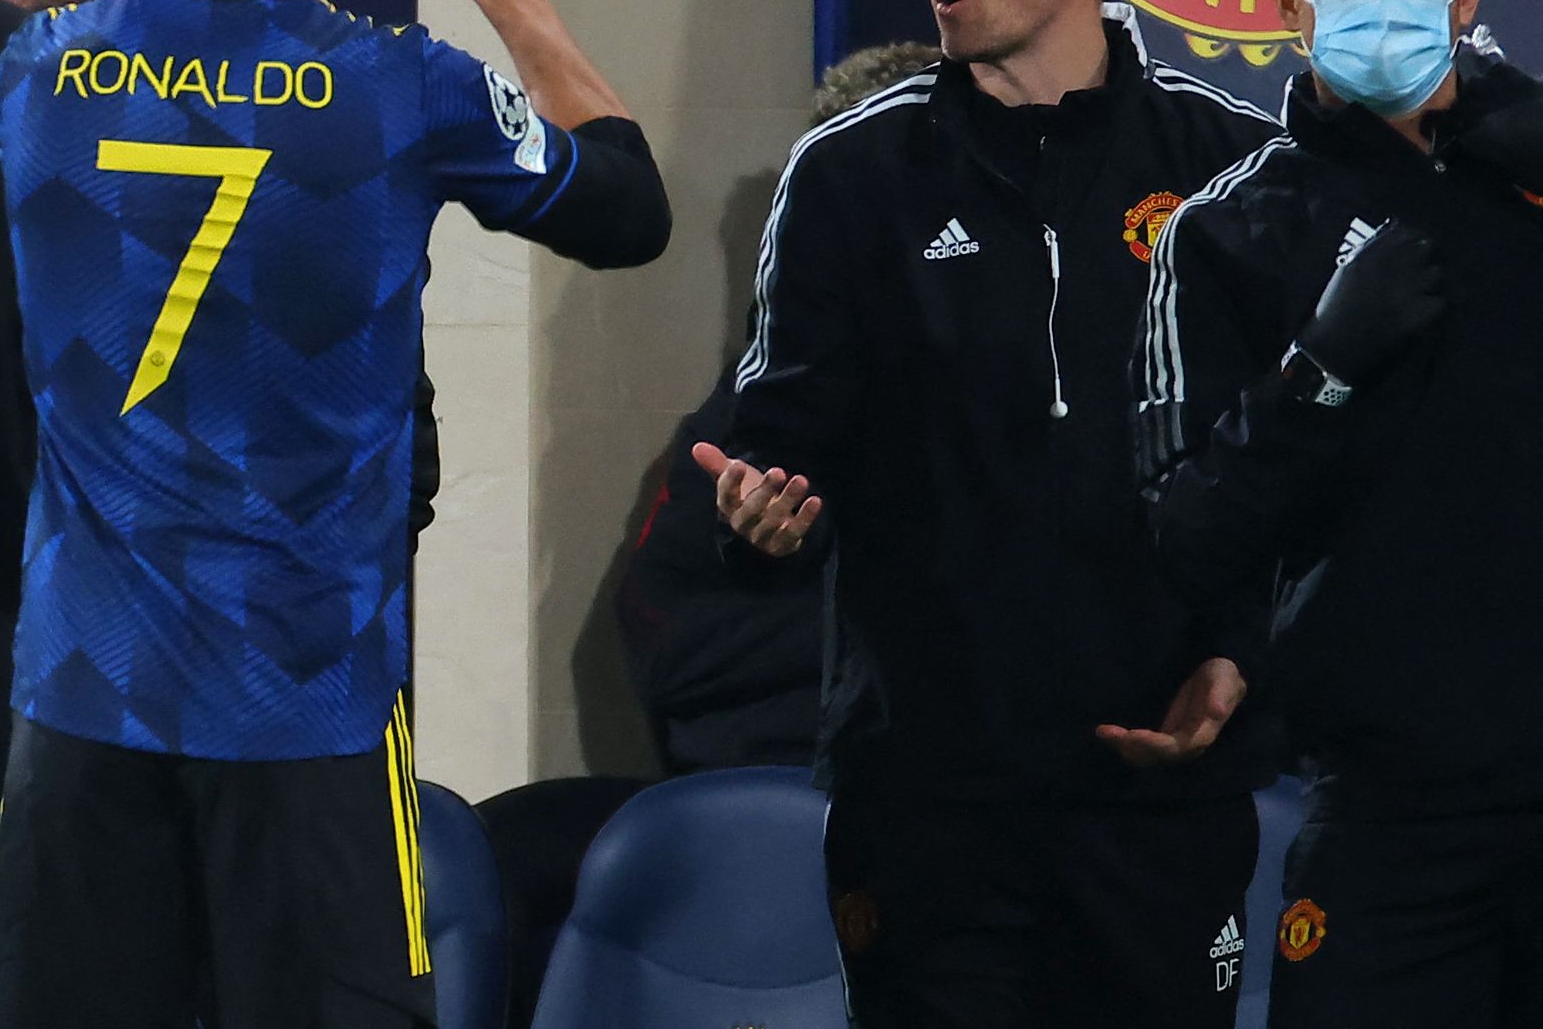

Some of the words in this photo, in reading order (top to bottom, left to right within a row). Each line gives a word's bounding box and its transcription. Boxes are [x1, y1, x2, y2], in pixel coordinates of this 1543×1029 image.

[53, 48, 335, 109] RONALDO
[923, 240, 980, 260] adidas
[95, 139, 274, 418] 7
[1209, 938, 1245, 959] adidas
[1216, 957, 1240, 992] DF
